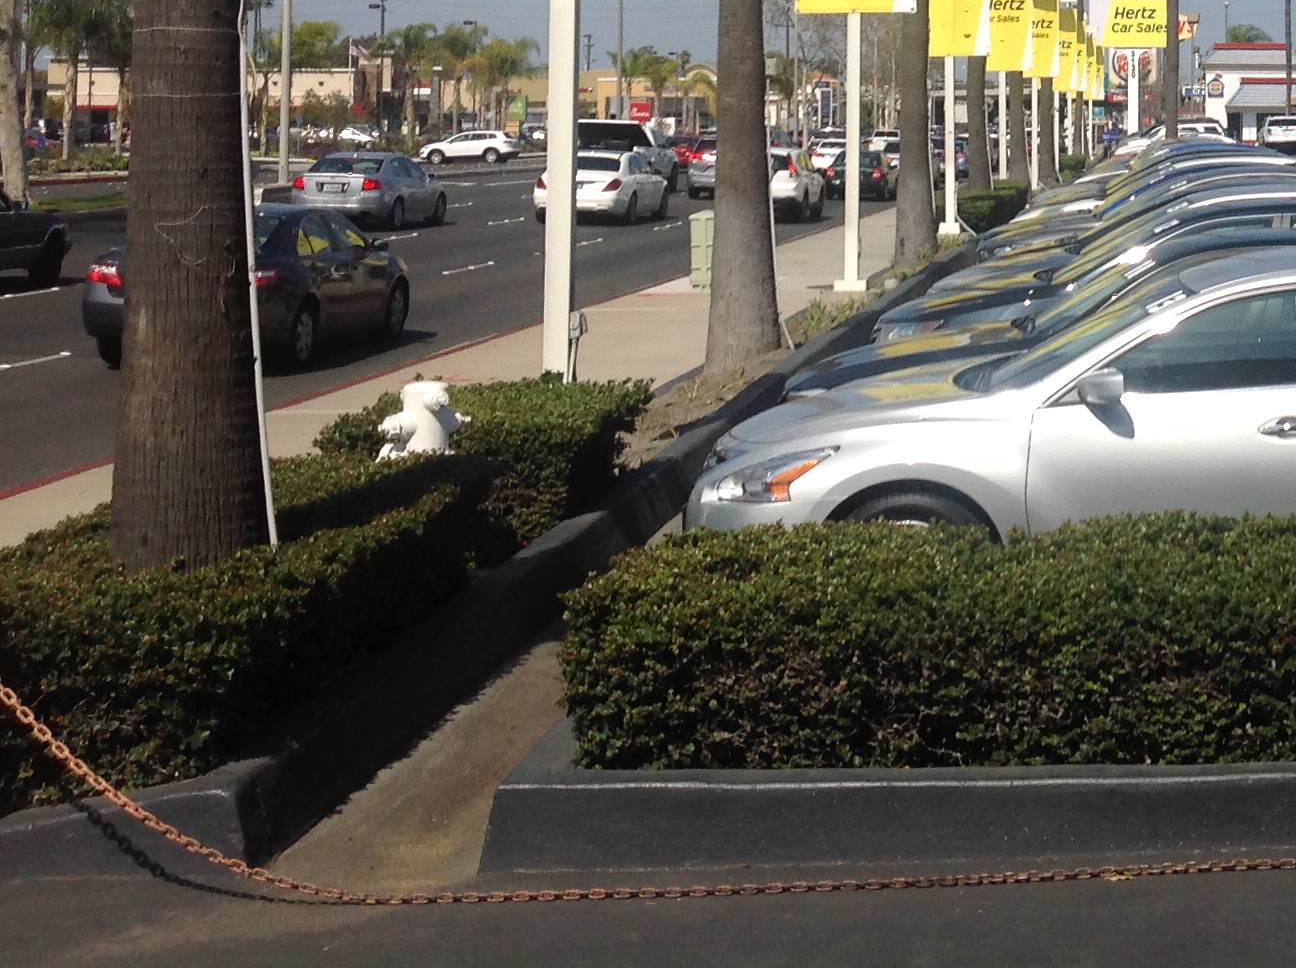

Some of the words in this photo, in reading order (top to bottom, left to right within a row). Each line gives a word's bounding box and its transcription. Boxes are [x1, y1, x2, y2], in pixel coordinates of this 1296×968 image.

[1113, 7, 1157, 20] Hertz
[1032, 18, 1053, 29] rtz
[1111, 22, 1134, 33] Car
[1136, 22, 1168, 33] Sales
